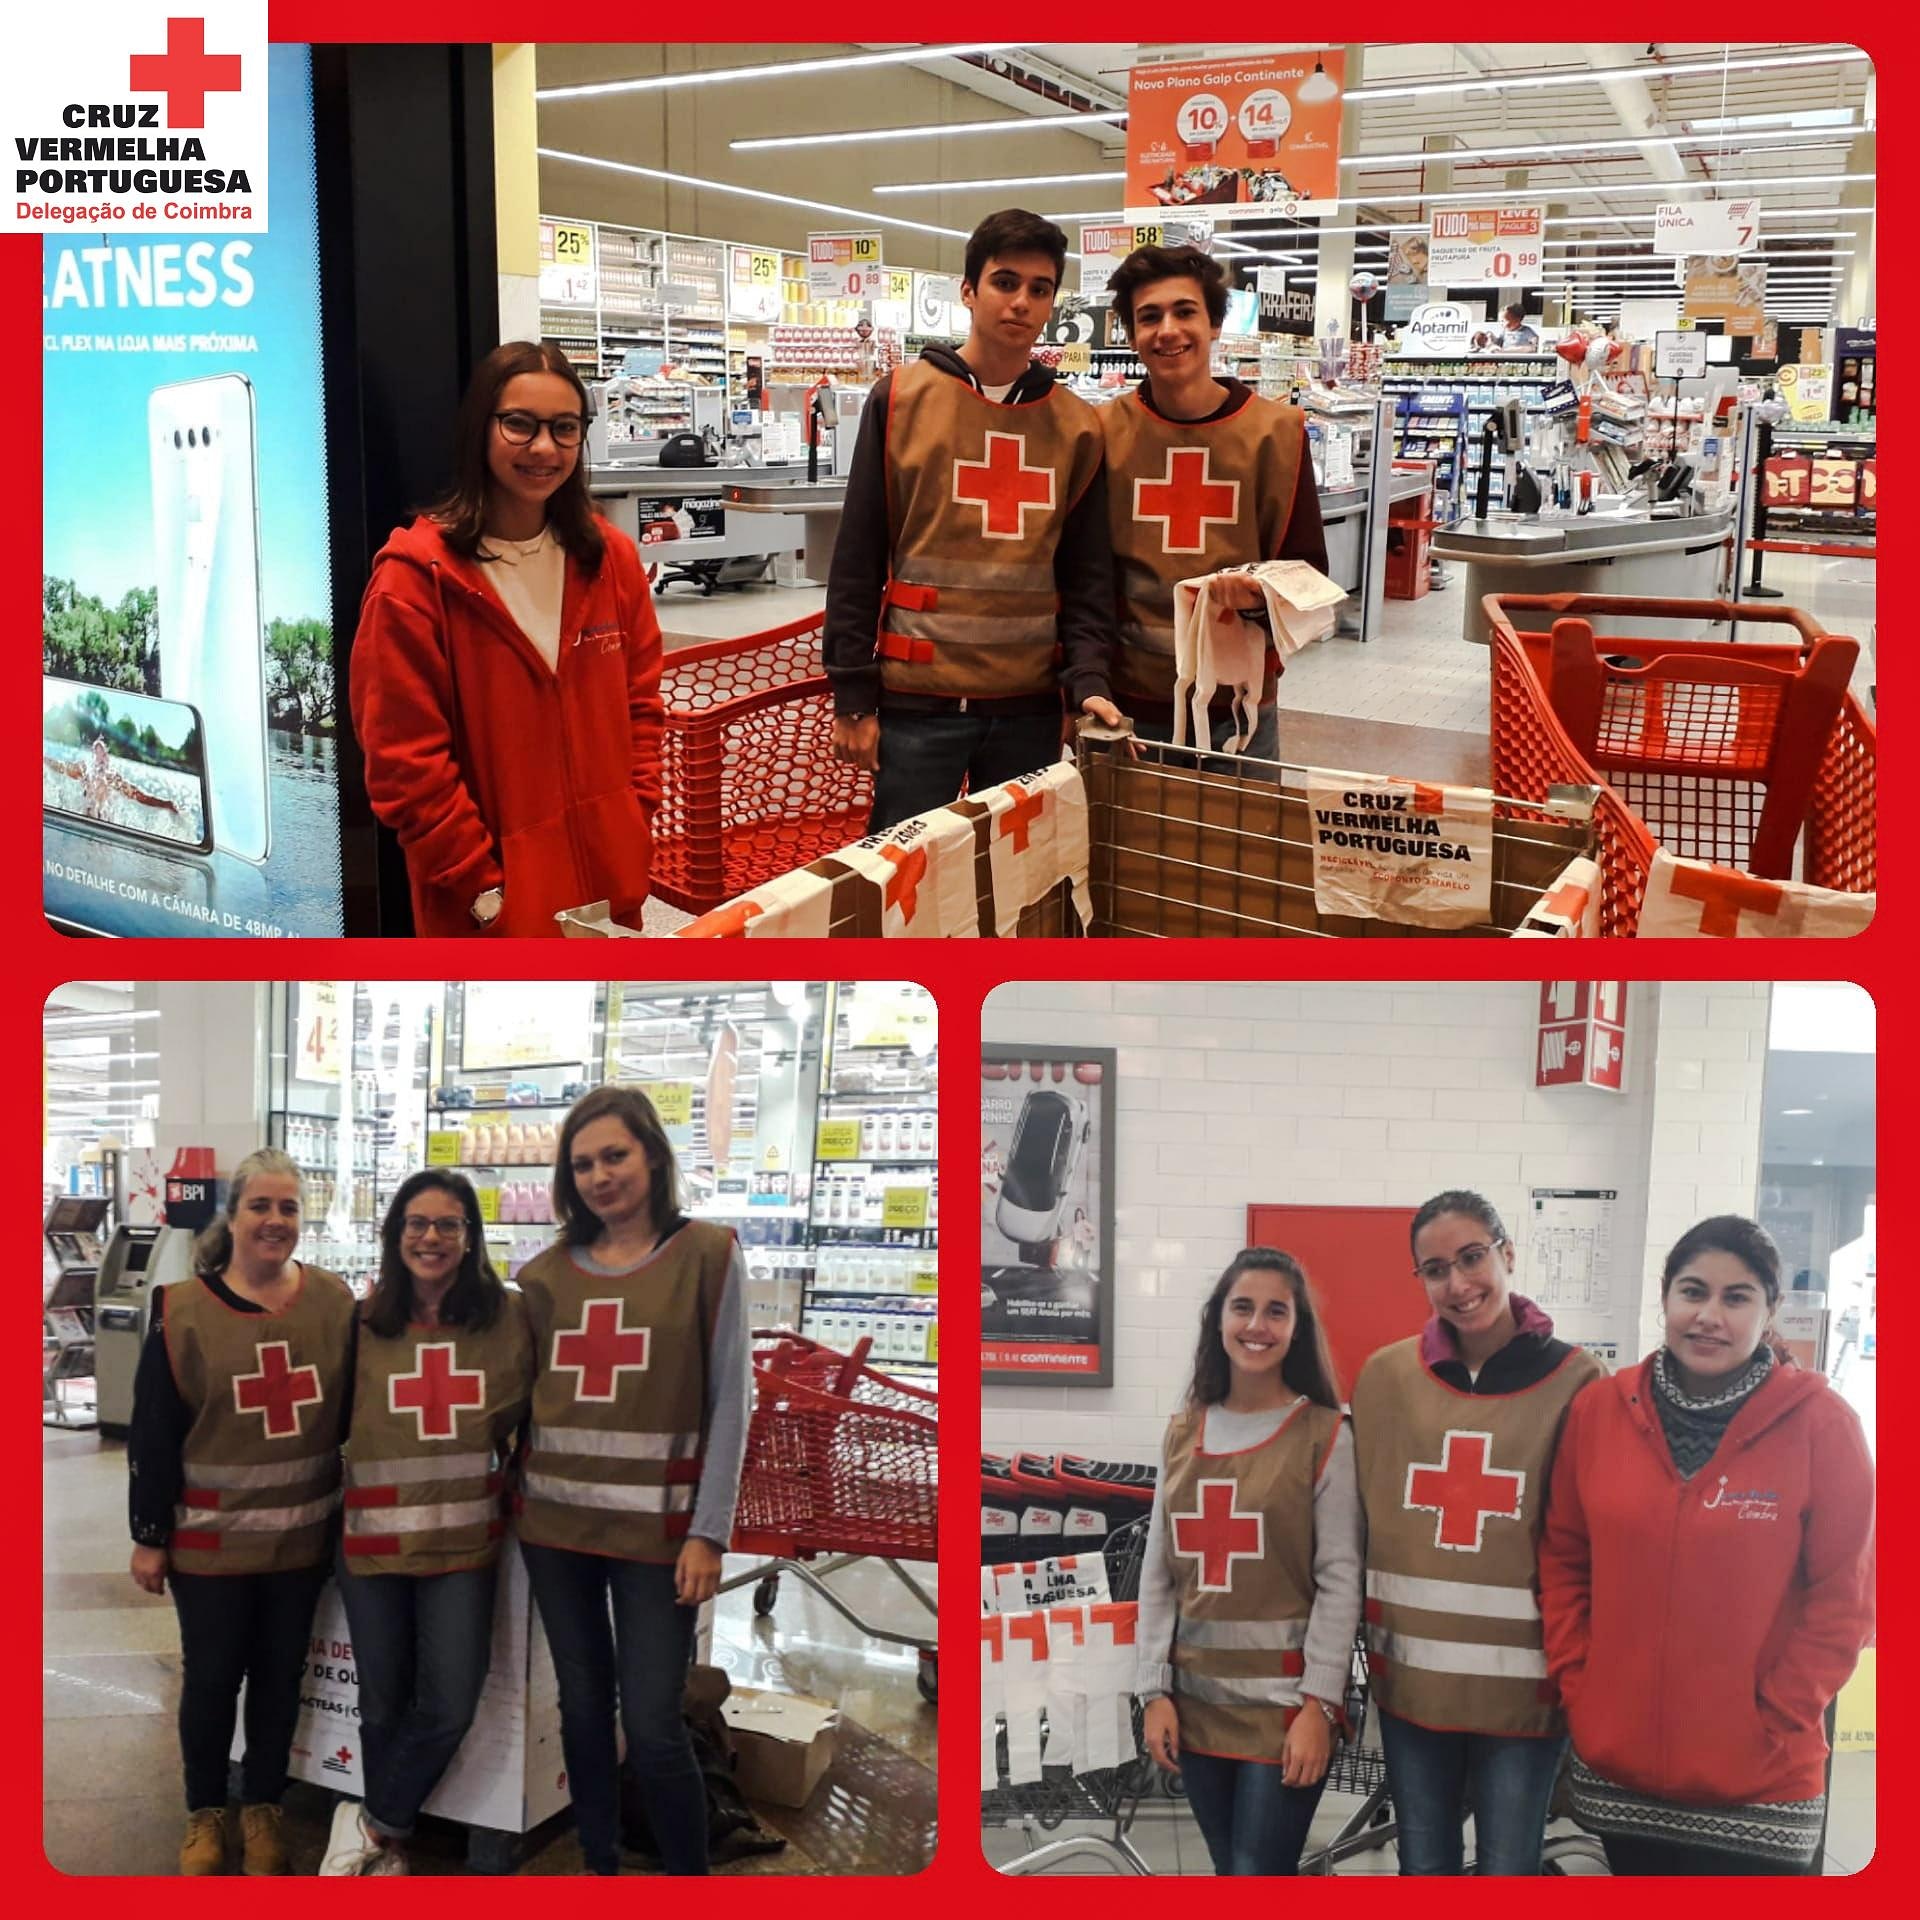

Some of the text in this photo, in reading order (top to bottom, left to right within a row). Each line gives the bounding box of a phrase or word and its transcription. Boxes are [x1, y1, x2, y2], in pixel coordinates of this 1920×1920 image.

[1134, 68, 1304, 91] Novo Plano Galp Continente
[1500, 208, 1538, 219] LEVE 4
[1658, 207, 1682, 215] FILA
[1435, 214, 1468, 237] TUDO
[1529, 222, 1537, 232] 3
[1658, 215, 1694, 228] ÚNICA
[1085, 231, 1110, 251] TUDO
[1737, 227, 1753, 246] 7
[42, 241, 255, 310] ATNESS
[1411, 320, 1469, 336] Aptamil
[95, 335, 115, 351] NA
[117, 335, 150, 352] LOJA
[153, 335, 187, 352] MAIS
[190, 330, 259, 353] PRÓXIMA
[1343, 792, 1407, 811] CRUZ
[1315, 810, 1441, 837] VERMELHA
[1318, 829, 1472, 862] PORTUGUESA
[44, 860, 64, 877] NO
[65, 864, 117, 895] DETALHE
[119, 882, 148, 905] COM
[151, 892, 160, 908] A
[163, 895, 219, 925] CÂMARA
[223, 912, 242, 932] DE
[182, 1183, 205, 1202] BPI
[313, 1664, 334, 1680] DE
